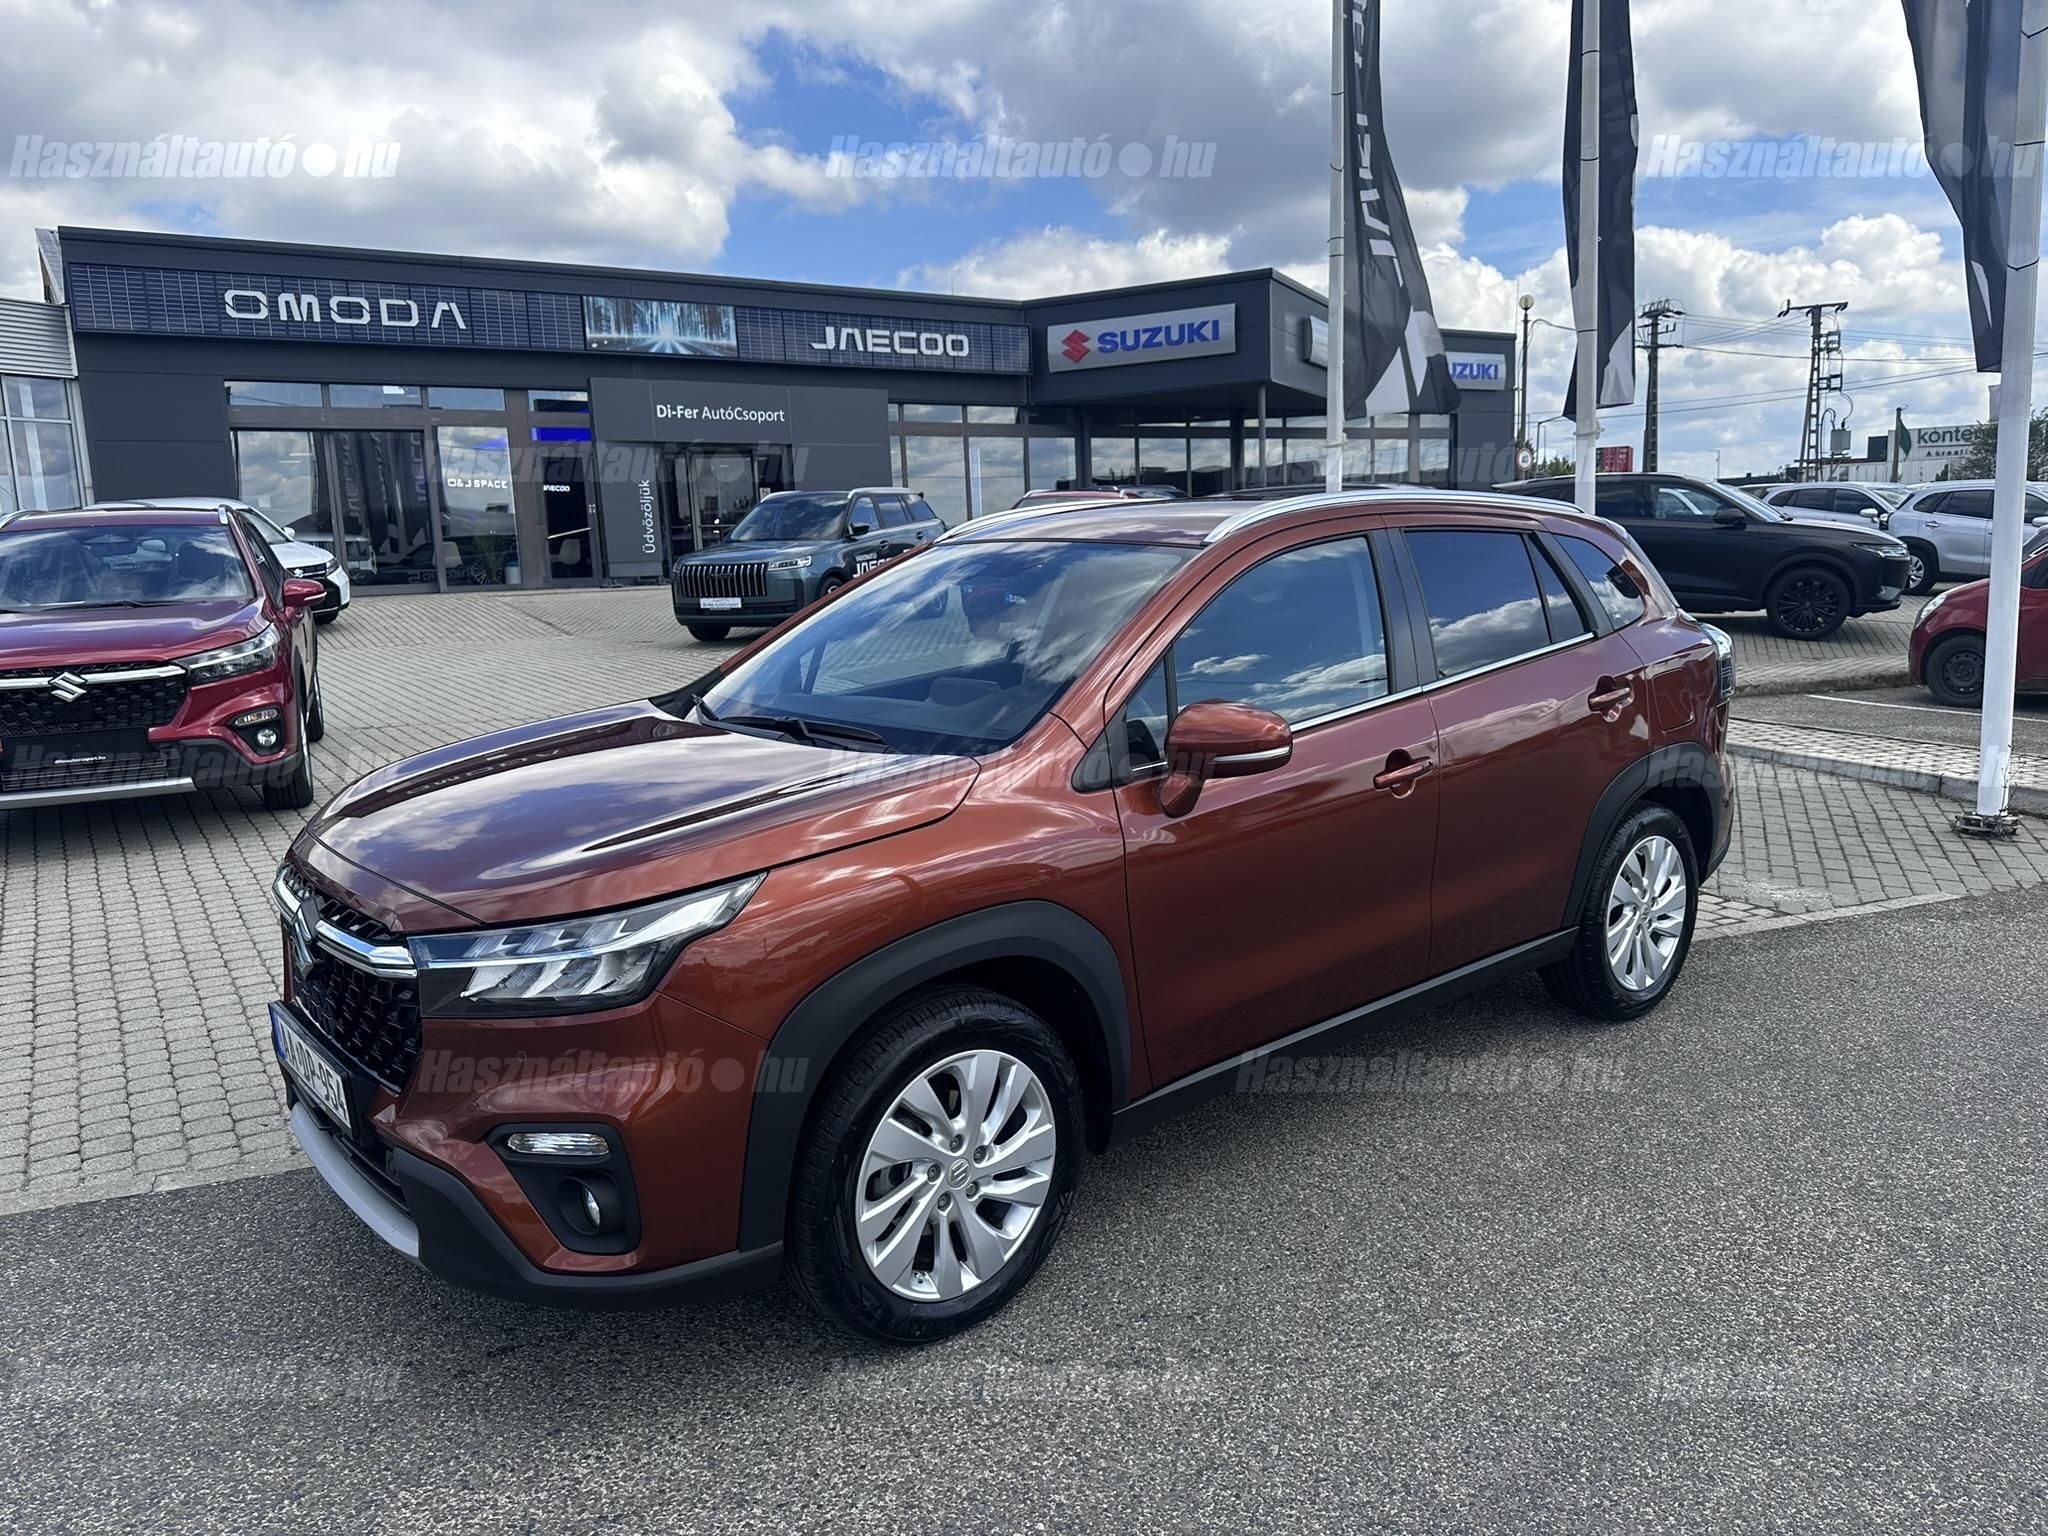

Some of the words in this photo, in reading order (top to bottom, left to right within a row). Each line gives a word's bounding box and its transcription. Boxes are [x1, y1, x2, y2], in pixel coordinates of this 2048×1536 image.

[224, 289, 467, 330] OMODA
[809, 326, 970, 357] JAECOO
[1097, 319, 1220, 354] SUZUKI
[656, 404, 699, 419] Di-Fer
[701, 405, 785, 424] AutóCsoport
[473, 479, 508, 489] SPACE
[638, 479, 656, 554] Üdvözöljük
